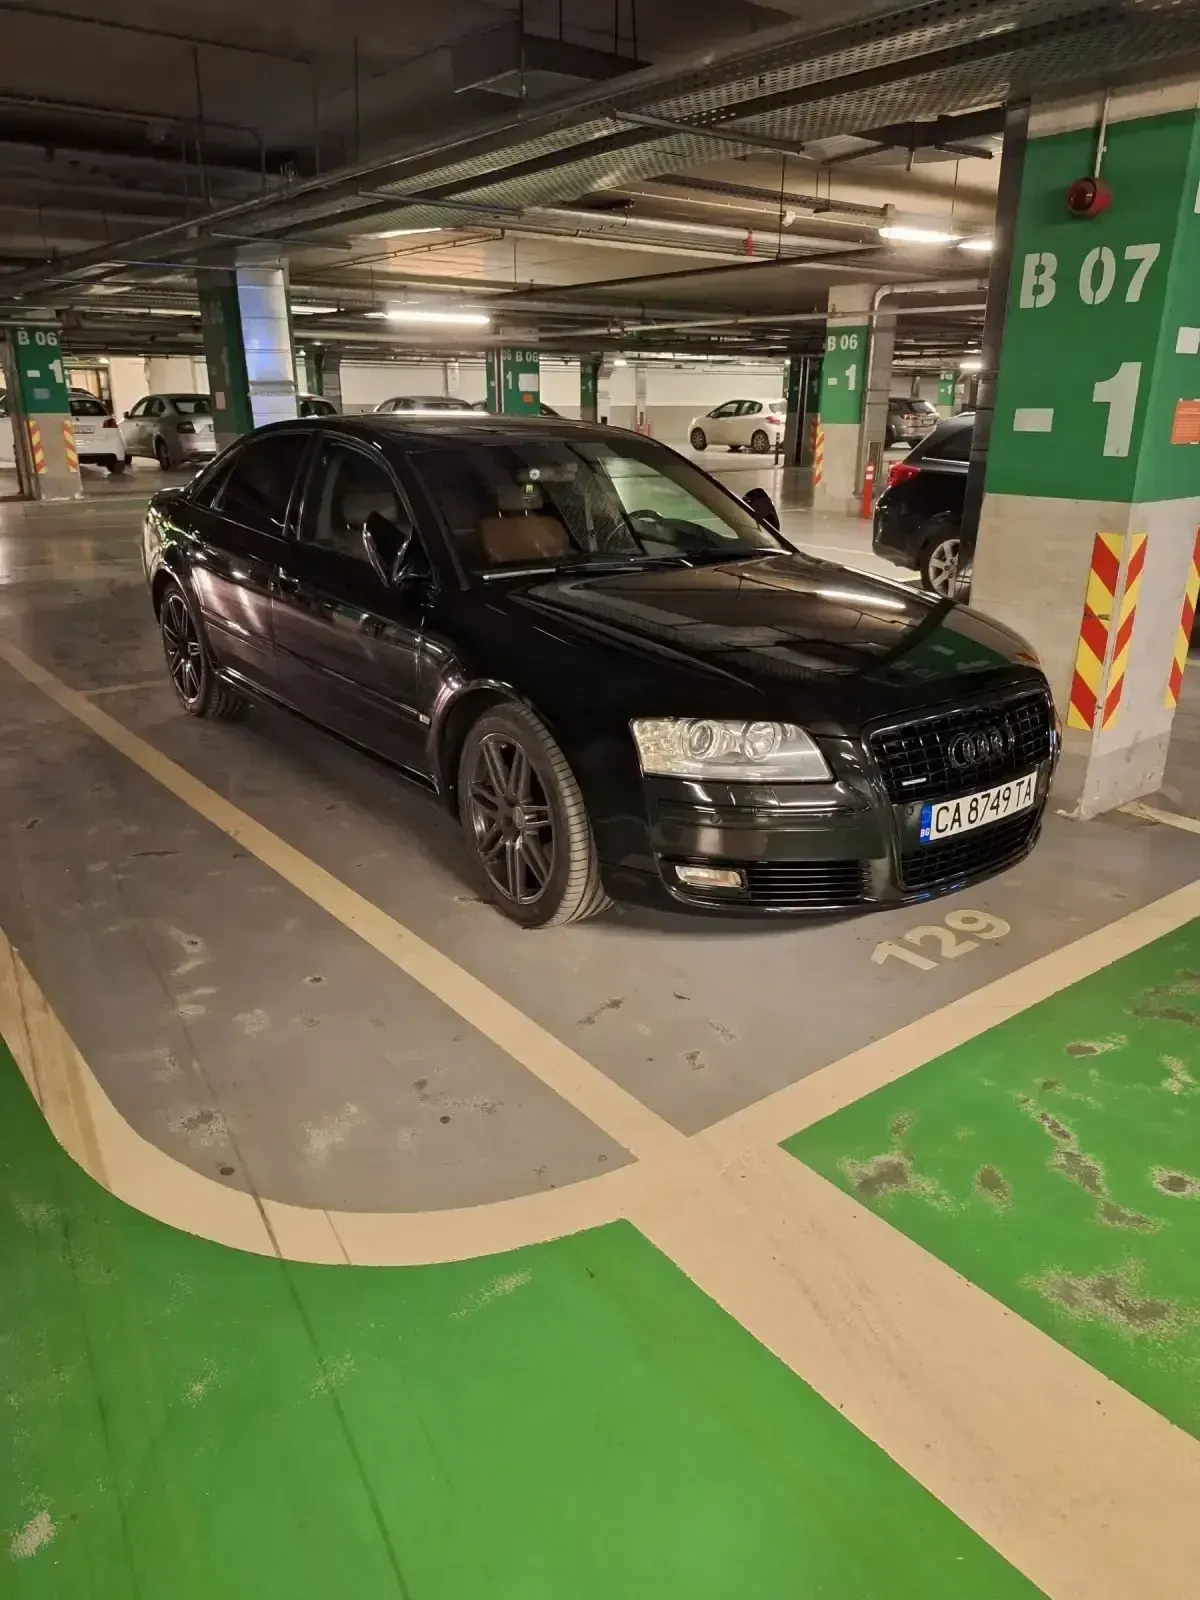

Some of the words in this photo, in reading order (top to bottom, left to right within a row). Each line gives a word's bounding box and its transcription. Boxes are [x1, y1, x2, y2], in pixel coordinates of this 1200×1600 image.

[1019, 252, 1058, 309] B
[1078, 243, 1161, 305] 07
[17, 331, 30, 346] B
[35, 331, 58, 346] 06
[516, 351, 523, 363] B
[525, 351, 539, 363] 06
[828, 336, 836, 351] B
[840, 333, 858, 350] 06
[1092, 361, 1142, 457] 1
[935, 805, 962, 833] CA
[967, 786, 1012, 825] 8749
[1015, 777, 1033, 808] TA
[920, 827, 930, 838] BG
[870, 909, 1011, 971] 129
